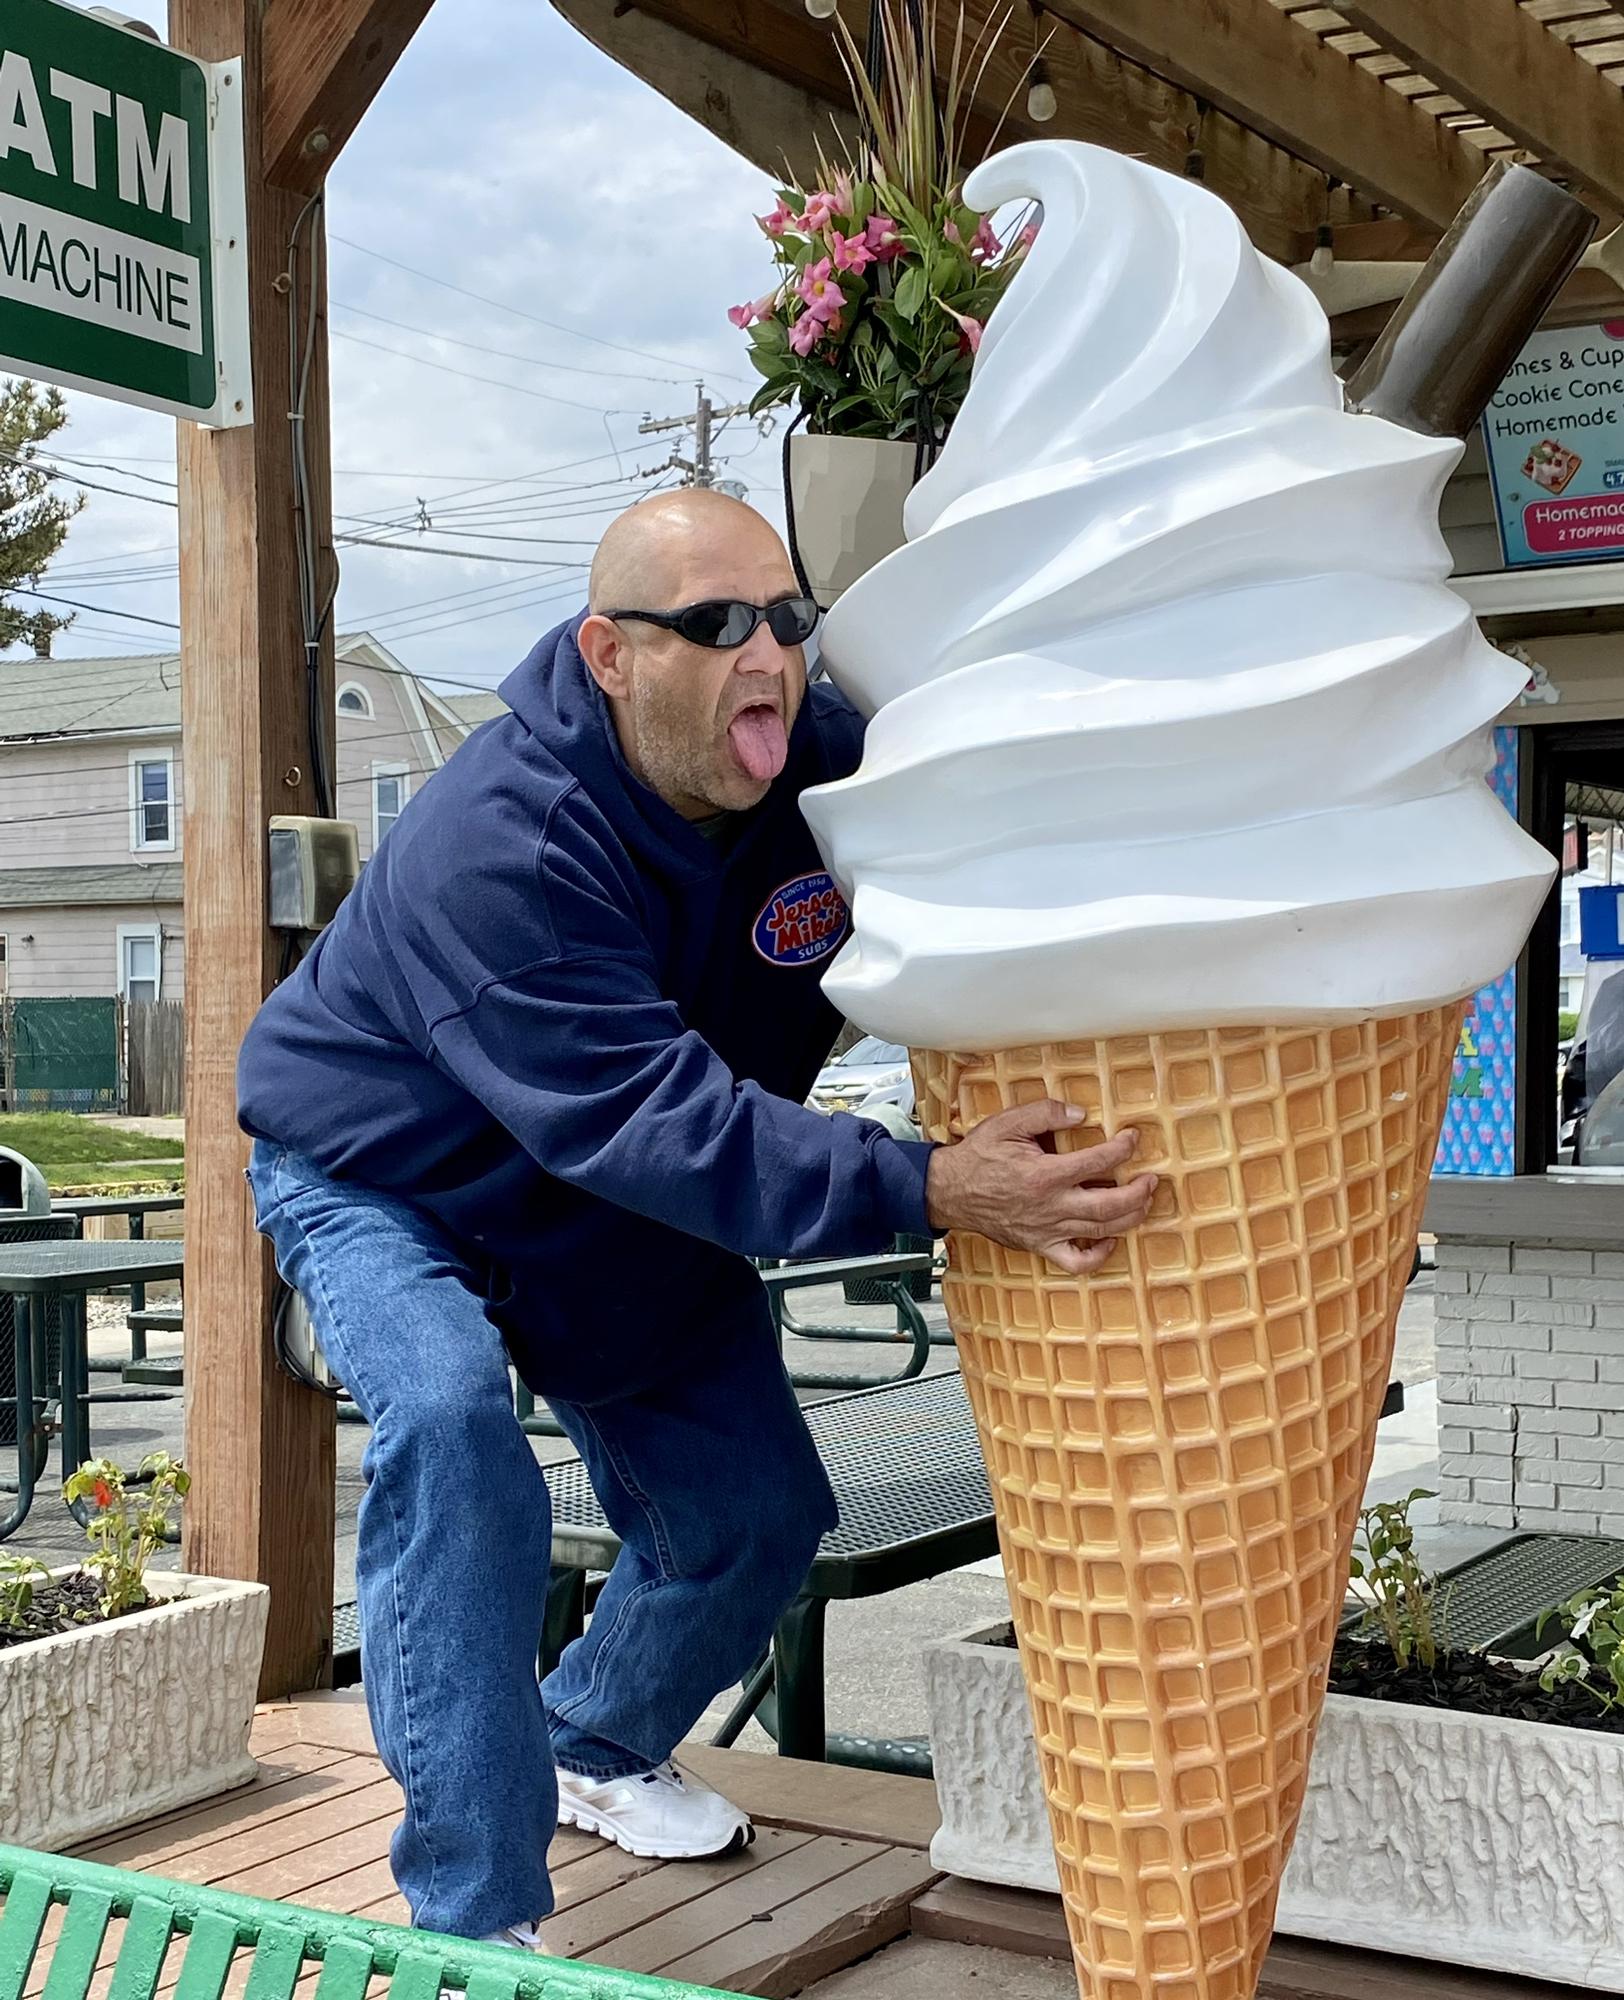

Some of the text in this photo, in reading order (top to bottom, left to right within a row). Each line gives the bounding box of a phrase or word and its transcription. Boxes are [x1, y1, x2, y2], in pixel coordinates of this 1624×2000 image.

[0, 50, 191, 224] ATM
[0, 222, 191, 331] MACHINE
[1560, 351, 1575, 370] &
[1491, 379, 1624, 408] Cookie Cone
[1496, 407, 1617, 437] Homemade
[1558, 523, 1624, 541] 2 TOPPING
[781, 882, 805, 899] SINCE
[798, 939, 828, 959] SUBS
